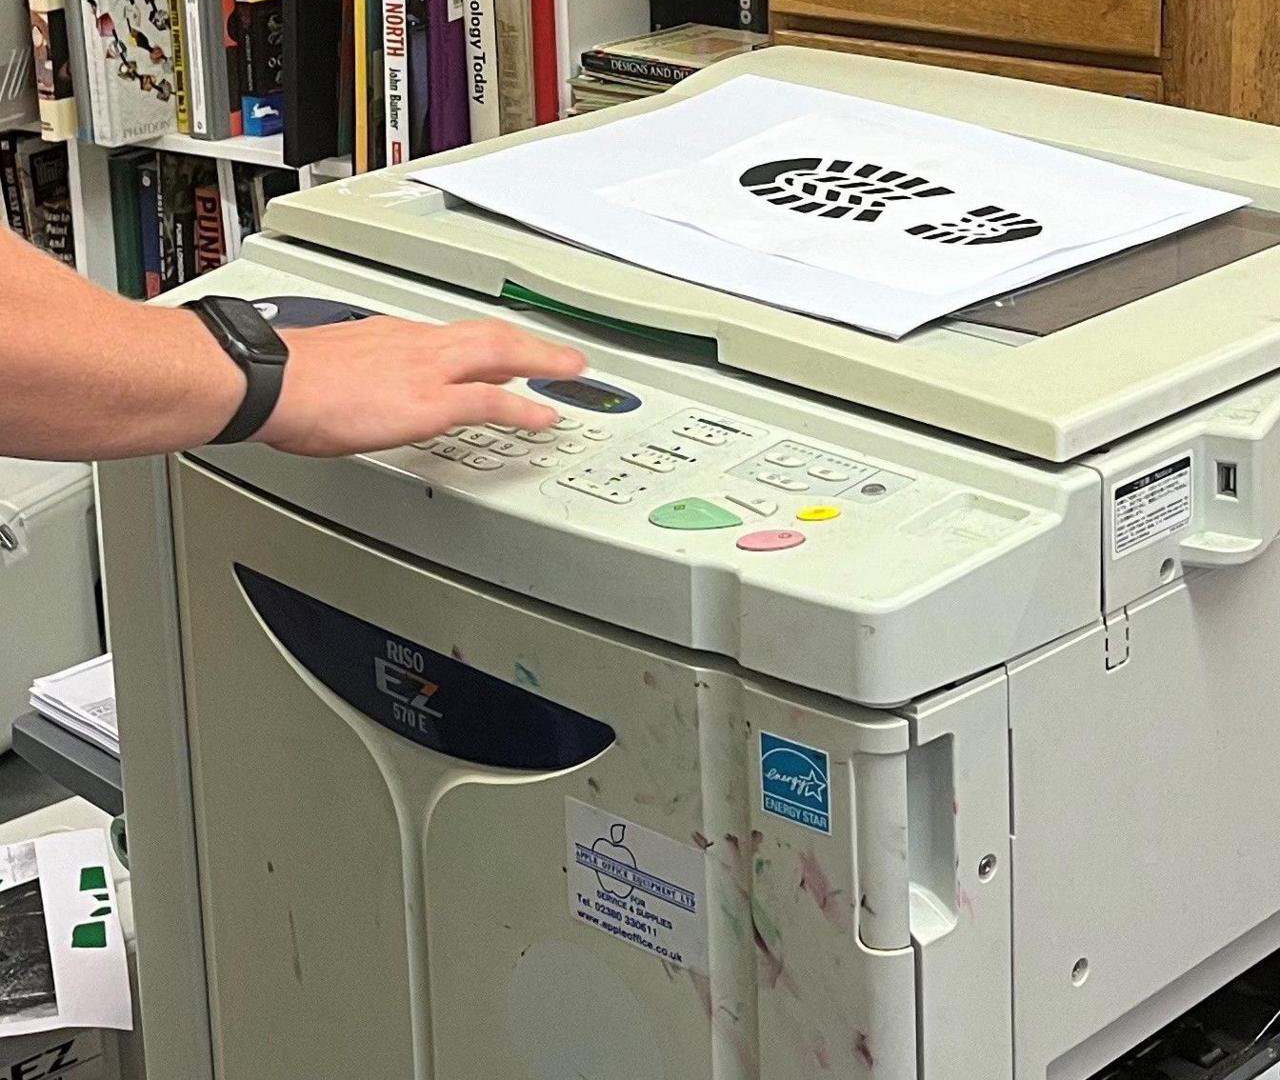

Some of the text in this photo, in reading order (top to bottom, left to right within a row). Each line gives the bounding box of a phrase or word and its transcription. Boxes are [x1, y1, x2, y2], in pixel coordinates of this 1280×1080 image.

[173, 29, 182, 67] FOOTBALL
[385, 2, 405, 58] NORTH
[472, 52, 485, 105] Today
[610, 59, 671, 79] DESIGNS AND
[388, 67, 402, 131] John Bulmer
[122, 119, 171, 140] PHAIDON
[197, 194, 221, 273] PUNK
[386, 639, 425, 673] RISO
[374, 656, 444, 719] EZ
[392, 701, 429, 734] 570 E
[765, 767, 807, 796] energy
[765, 797, 827, 828] ENERGY STAR
[576, 850, 696, 907] APPLE OFFICE EQUIPMENT LTD
[577, 892, 592, 909] Tel.
[596, 889, 673, 930] SERVICE SUPPLIES
[630, 895, 646, 908] FOR
[10, 1039, 77, 1080] EZ
